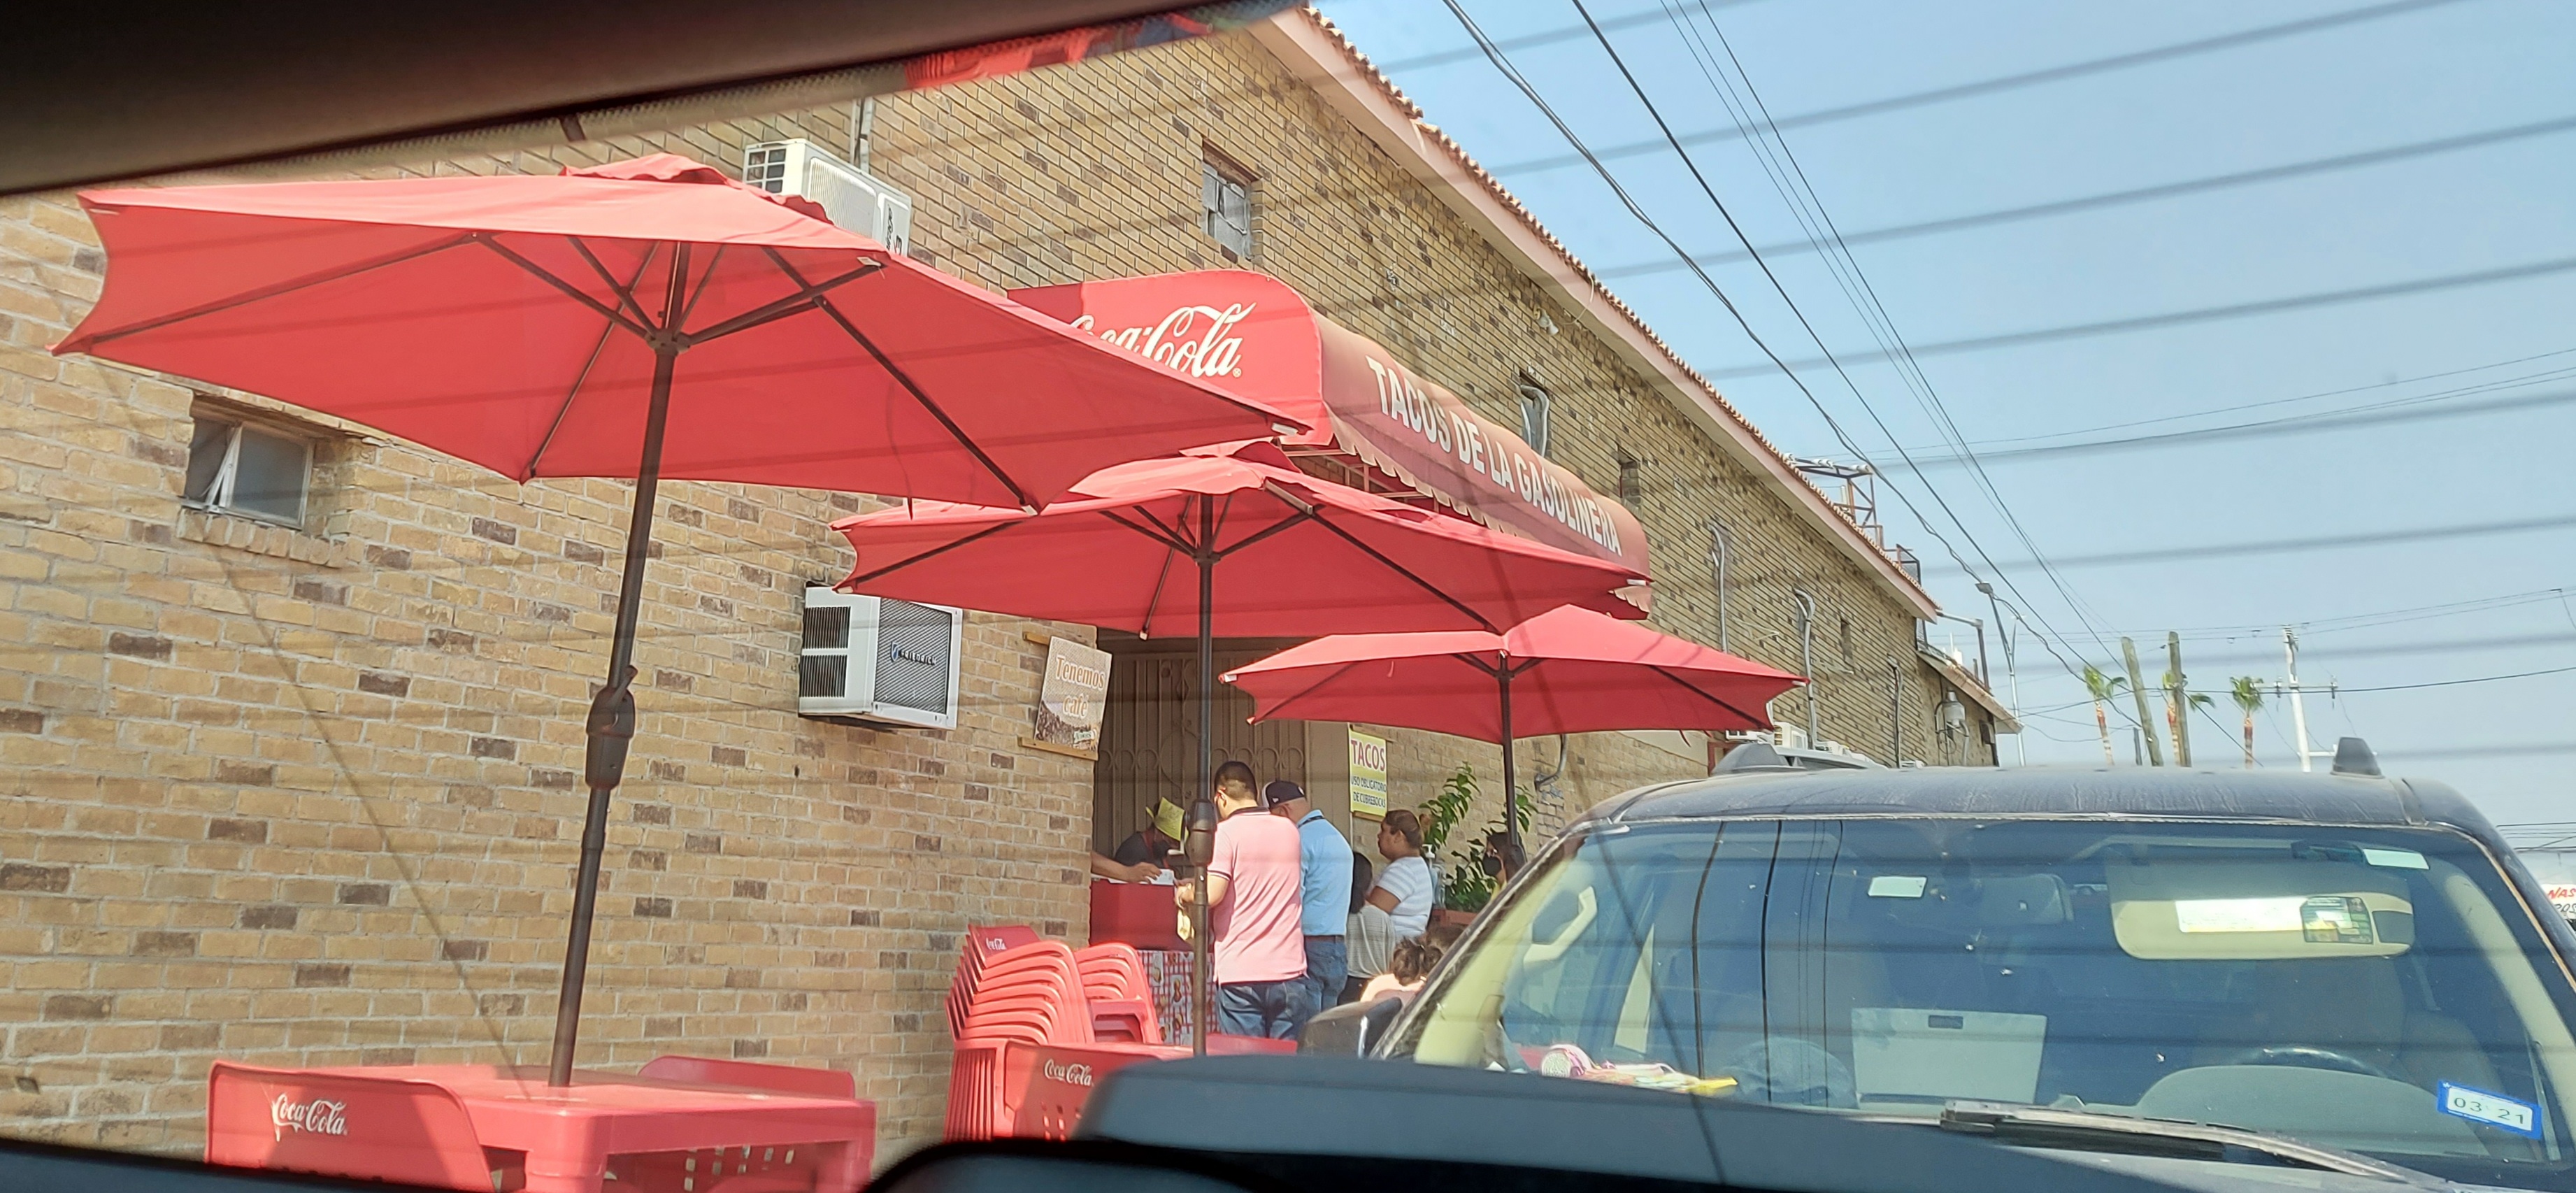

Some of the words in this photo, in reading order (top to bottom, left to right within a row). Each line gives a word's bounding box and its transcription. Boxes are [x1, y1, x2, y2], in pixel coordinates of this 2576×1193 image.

[1070, 302, 1257, 378] a-Cola
[1366, 355, 1452, 453] TACOS
[1449, 410, 1487, 475] DE
[1482, 432, 1516, 494] LA
[1514, 453, 1622, 557] GASOLINERA
[1055, 655, 1105, 690] Tenemos
[1063, 694, 1088, 716] café
[1351, 740, 1385, 771] TACOS
[1351, 776, 1360, 786] USO
[1353, 792, 1359, 801] DE
[2454, 1097, 2482, 1112] 03
[2498, 1109, 2524, 1124] 21
